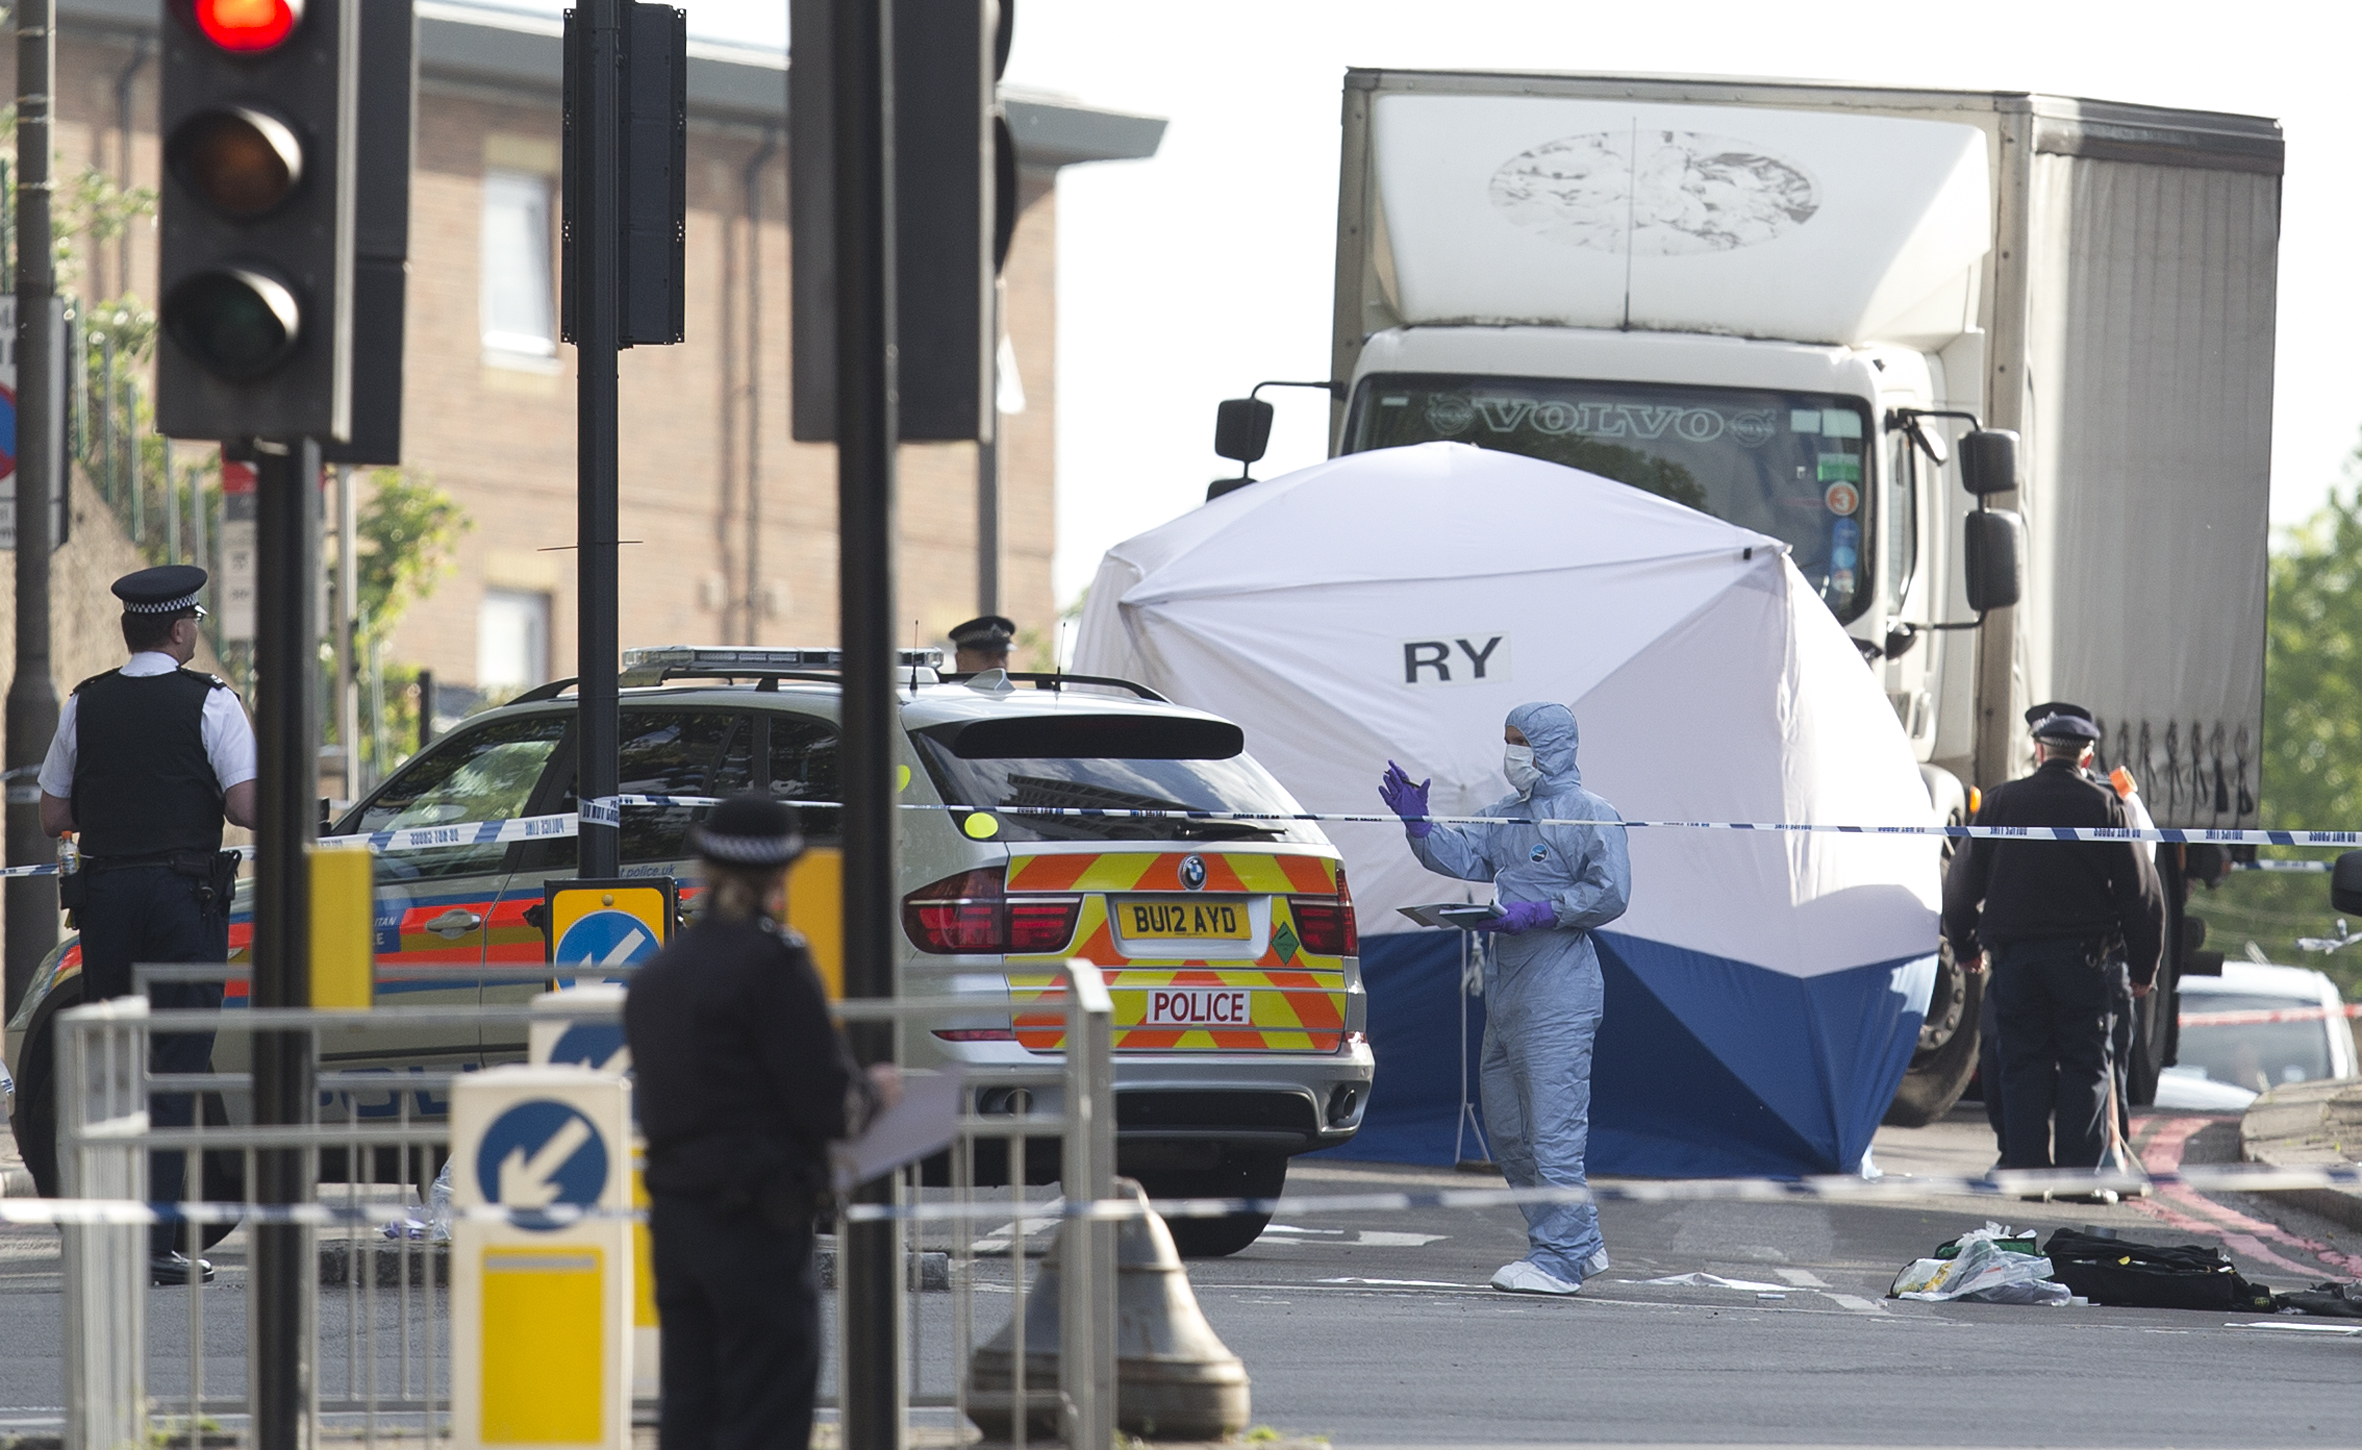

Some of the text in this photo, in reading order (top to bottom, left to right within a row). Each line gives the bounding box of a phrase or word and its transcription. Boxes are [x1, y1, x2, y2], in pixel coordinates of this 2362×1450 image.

[1471, 397, 1725, 442] VOLVO
[1404, 636, 1503, 683] RY
[1133, 905, 1236, 933] BU12 AYD
[1154, 992, 1245, 1022] POLICE
